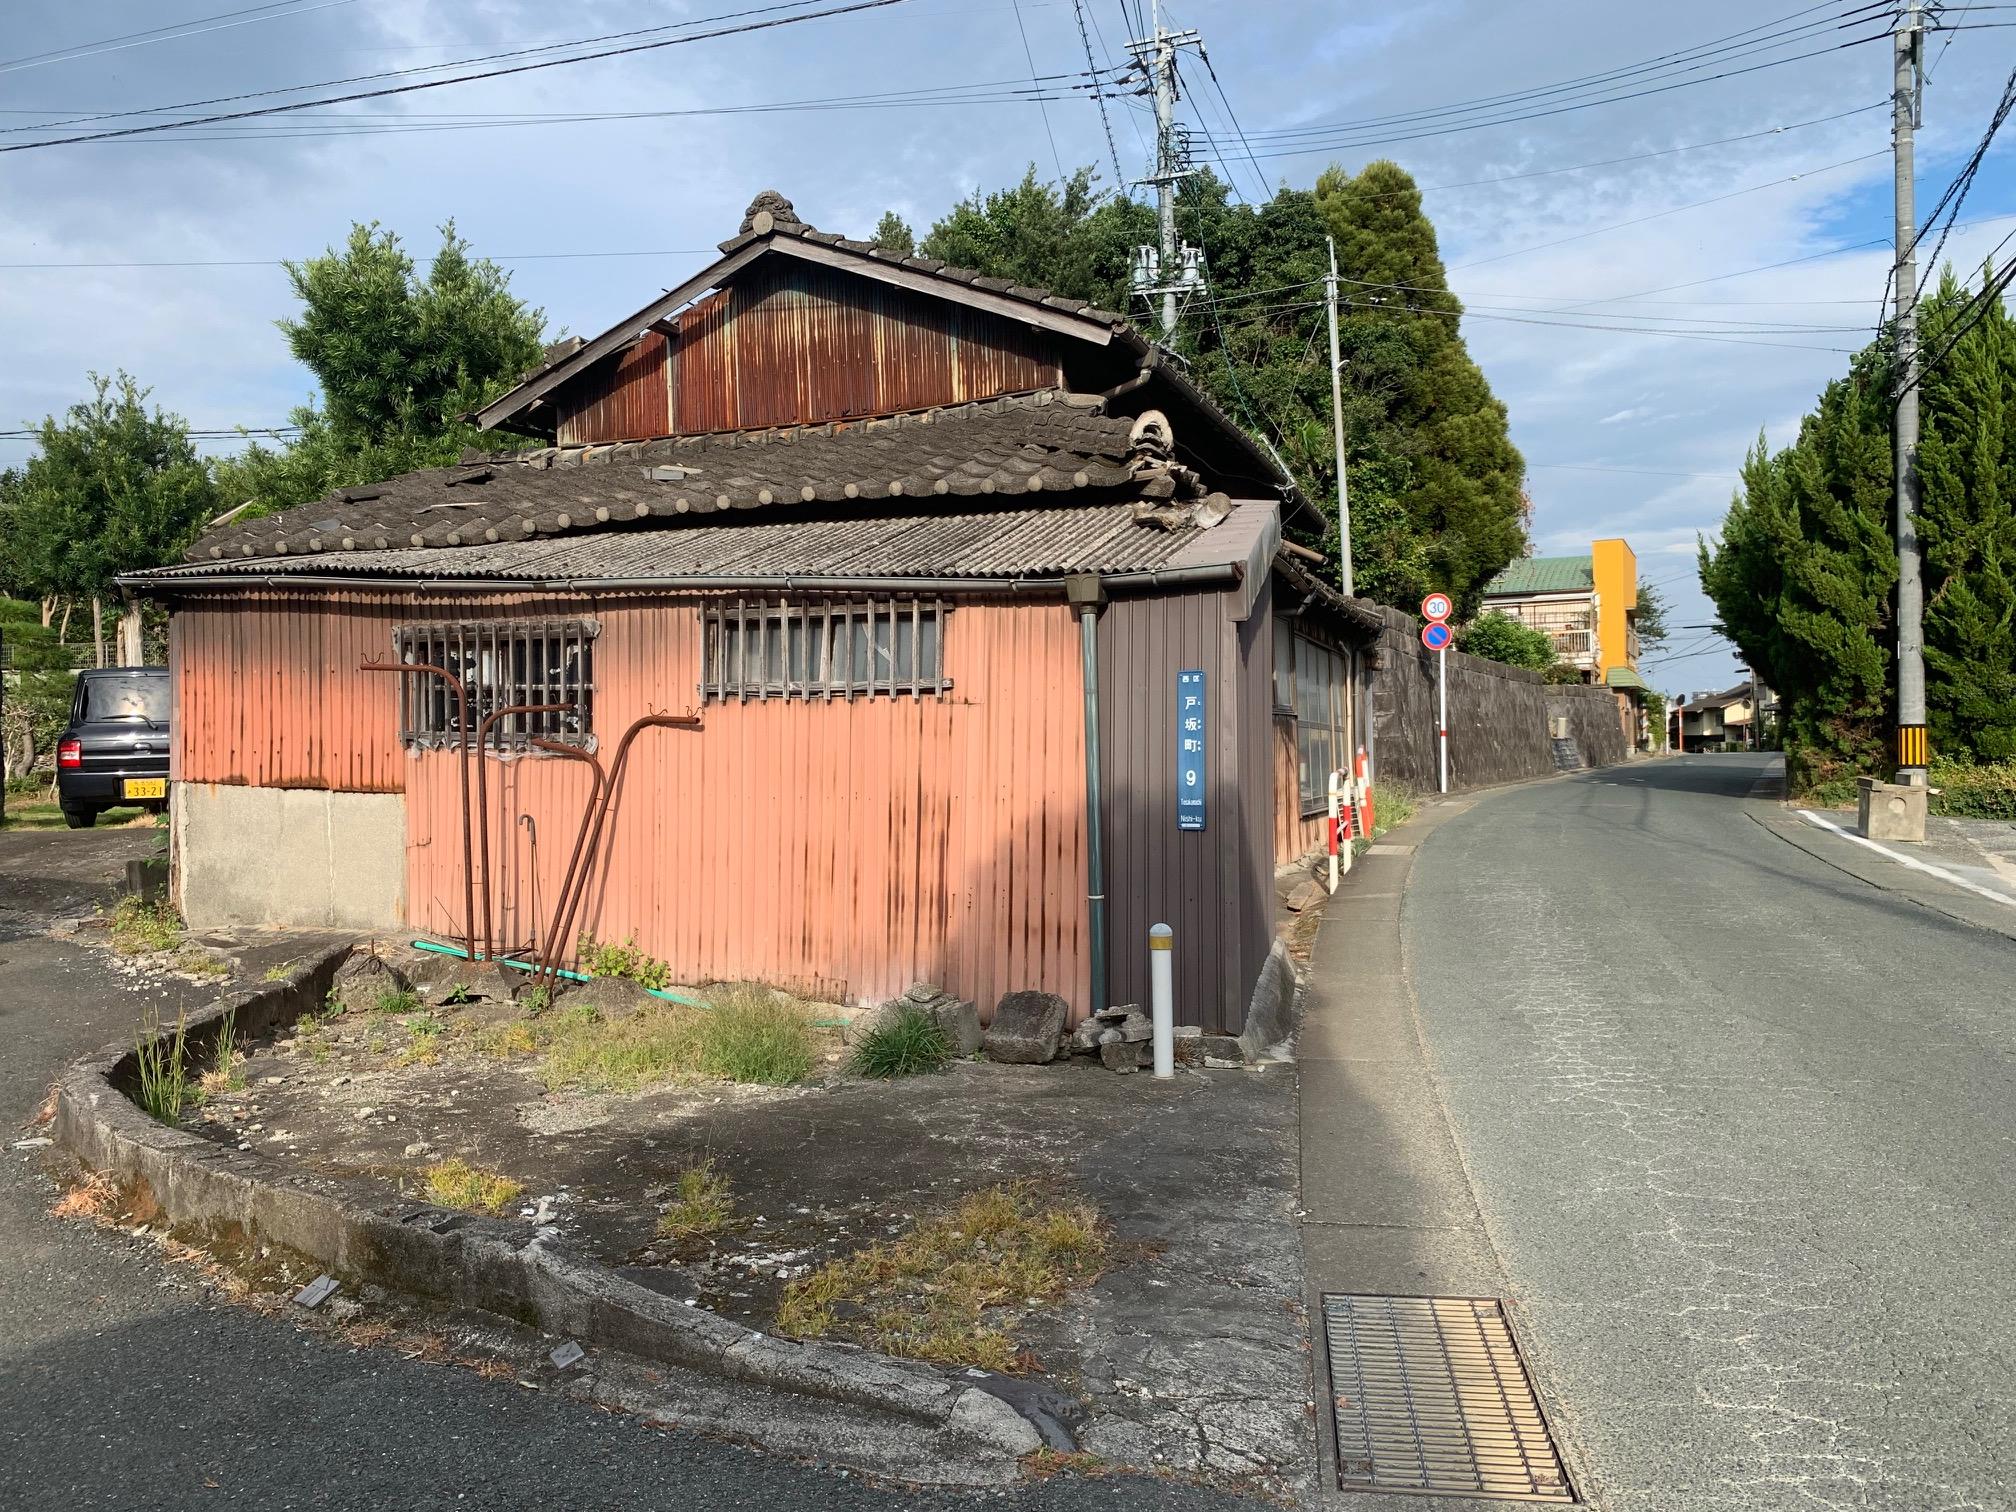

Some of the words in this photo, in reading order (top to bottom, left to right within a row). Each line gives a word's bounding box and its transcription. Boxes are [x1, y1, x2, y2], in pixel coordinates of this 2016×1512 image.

[1429, 602, 1445, 613] 30
[1185, 696, 1197, 753] 戸坂町
[1186, 770, 1196, 786] 9
[134, 787, 162, 796] 33-21
